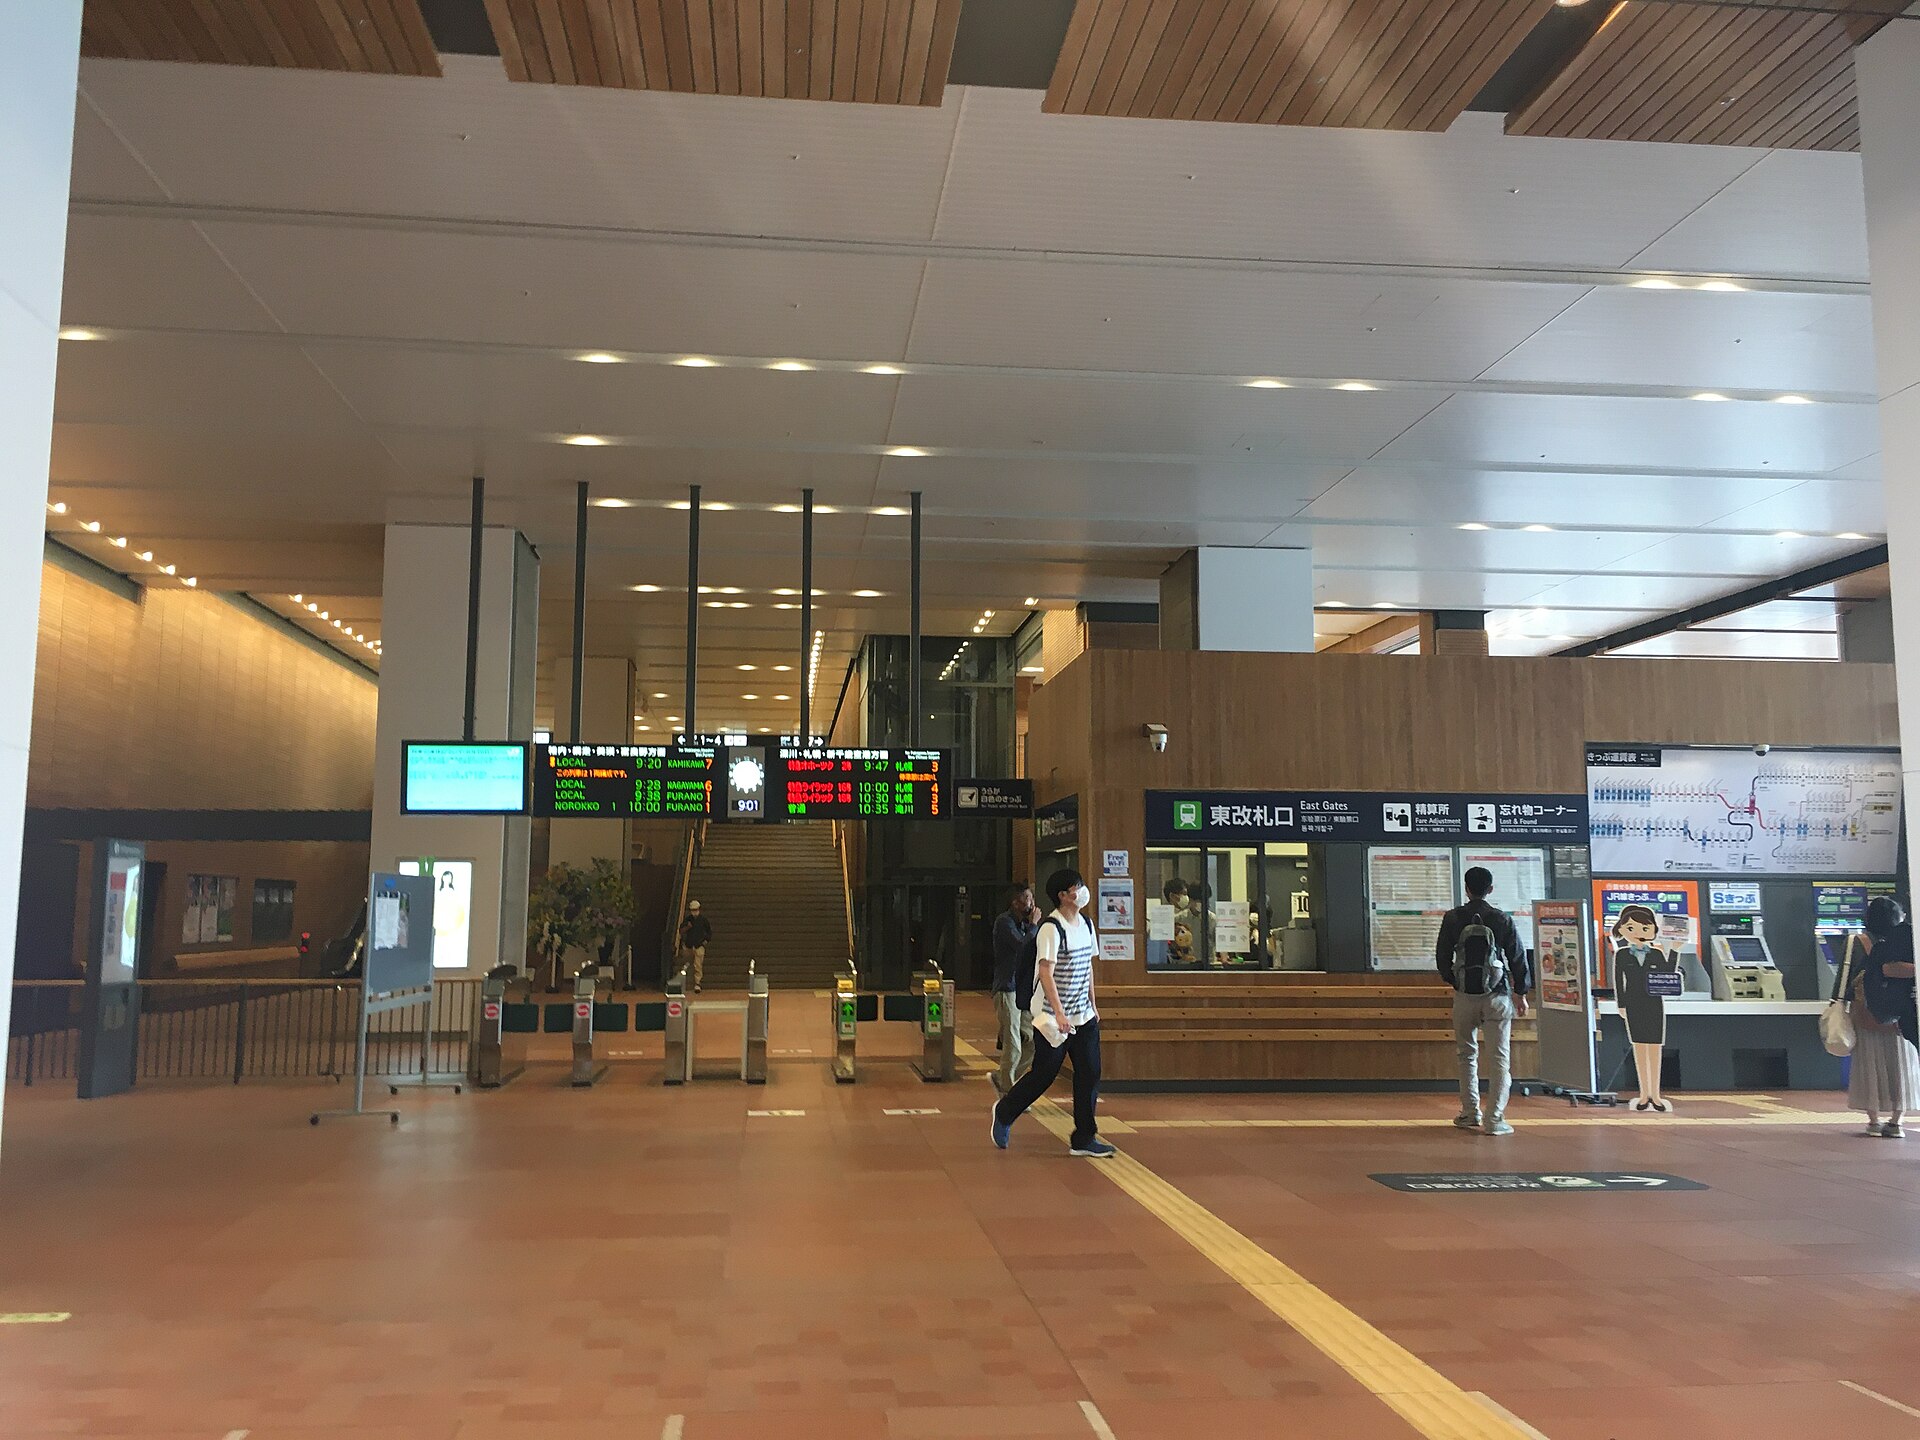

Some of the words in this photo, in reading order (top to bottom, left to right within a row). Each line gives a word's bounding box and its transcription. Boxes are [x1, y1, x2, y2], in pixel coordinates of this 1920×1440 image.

[556, 758, 587, 767] LOCAL
[636, 758, 662, 769] 9:20
[667, 760, 705, 768] KAMIKAWA
[705, 758, 713, 770] 7
[864, 761, 889, 771] 9:47
[931, 762, 939, 772] 3
[555, 779, 586, 789] LOCAL
[635, 780, 661, 790] 9:28
[704, 780, 713, 792] 6
[859, 783, 889, 793] 10:00
[931, 783, 939, 793] 4
[555, 790, 586, 800] LOCAL
[666, 791, 703, 801] FURANO
[859, 793, 889, 803] 10:30
[931, 793, 939, 804] 3
[555, 801, 600, 811] NOROKKO
[629, 801, 661, 813] 10:00
[666, 802, 703, 812] FURANO
[859, 803, 889, 814] 10:35
[931, 804, 939, 815] 5
[1300, 800, 1320, 811] East
[1322, 800, 1348, 811] Gates
[1415, 803, 1450, 816] 精算所
[1499, 804, 1578, 817] 忘れ物コーナー
[1209, 804, 1294, 827] 東改札口
[1107, 853, 1125, 861] Free
[1713, 892, 1756, 904] Sきっぷ
